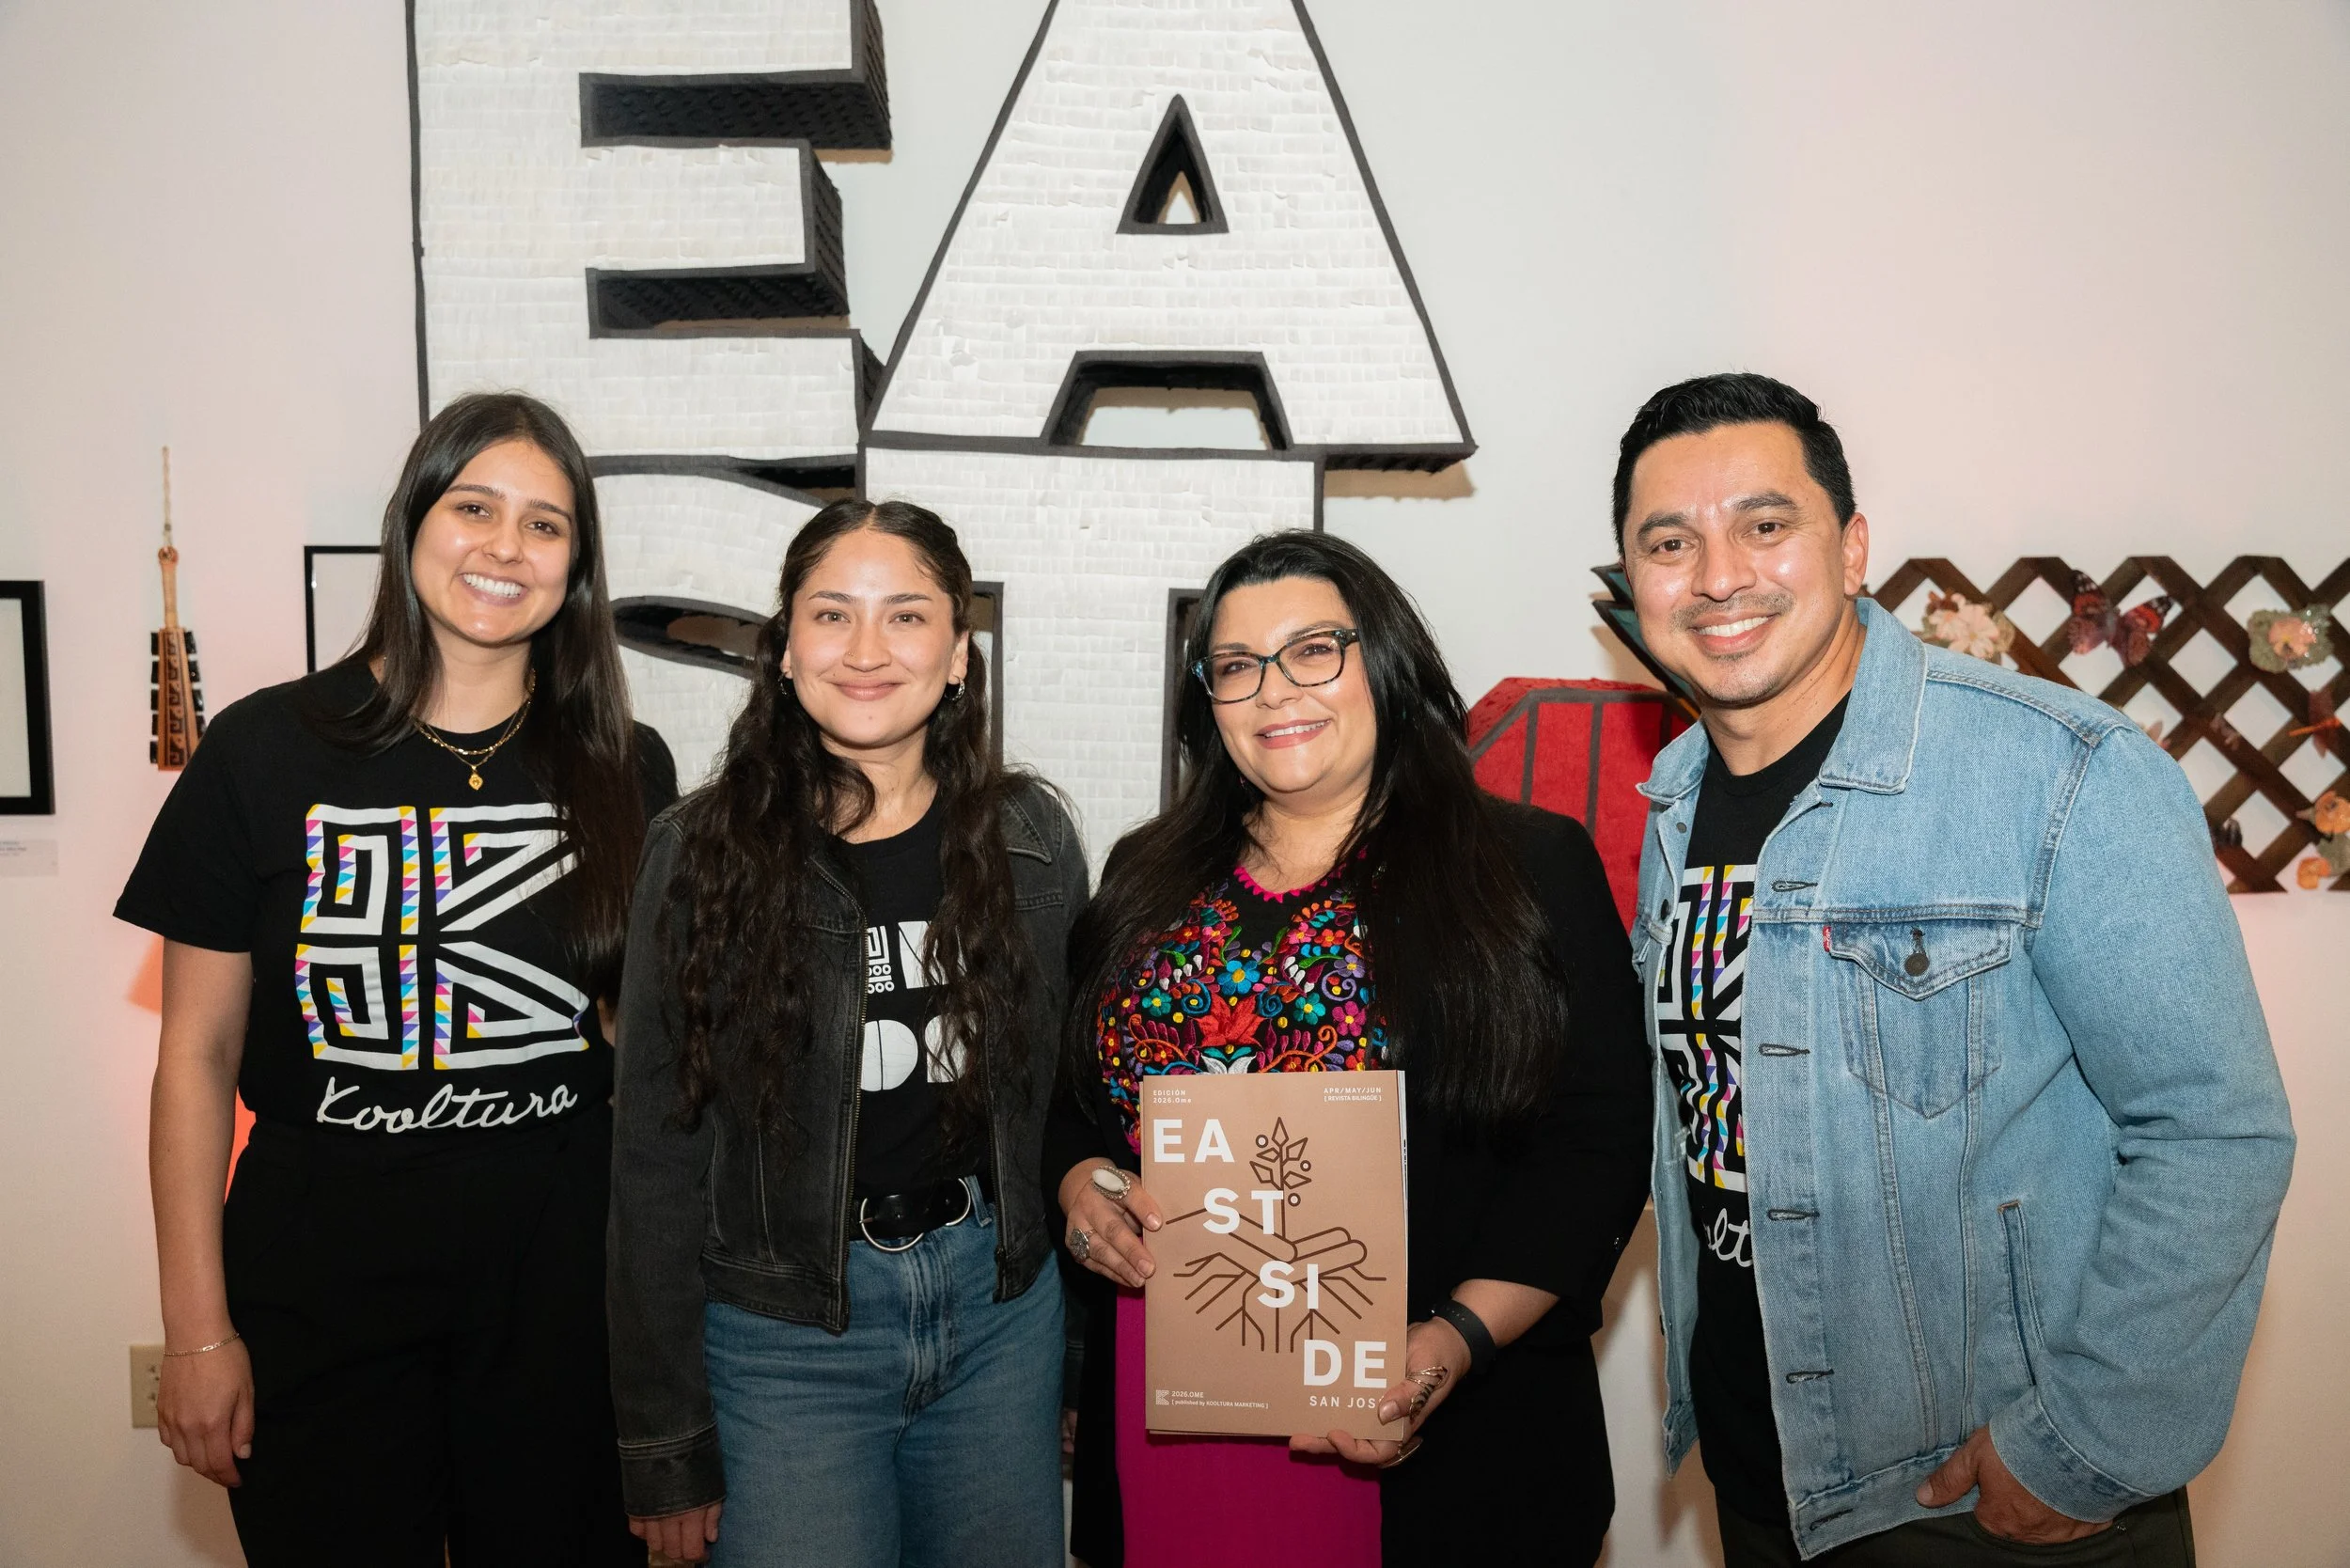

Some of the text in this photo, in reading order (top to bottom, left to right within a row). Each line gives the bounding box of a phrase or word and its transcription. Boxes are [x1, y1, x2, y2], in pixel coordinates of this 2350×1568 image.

[316, 1076, 579, 1134] Kooltura
[1152, 1088, 1186, 1096] EDICIÓN
[1153, 1119, 1235, 1163] EA
[1202, 1187, 1284, 1234] ST
[1257, 1260, 1319, 1309] SI
[1303, 1339, 1387, 1388] DE
[1308, 1395, 1384, 1409] SAN JOS
